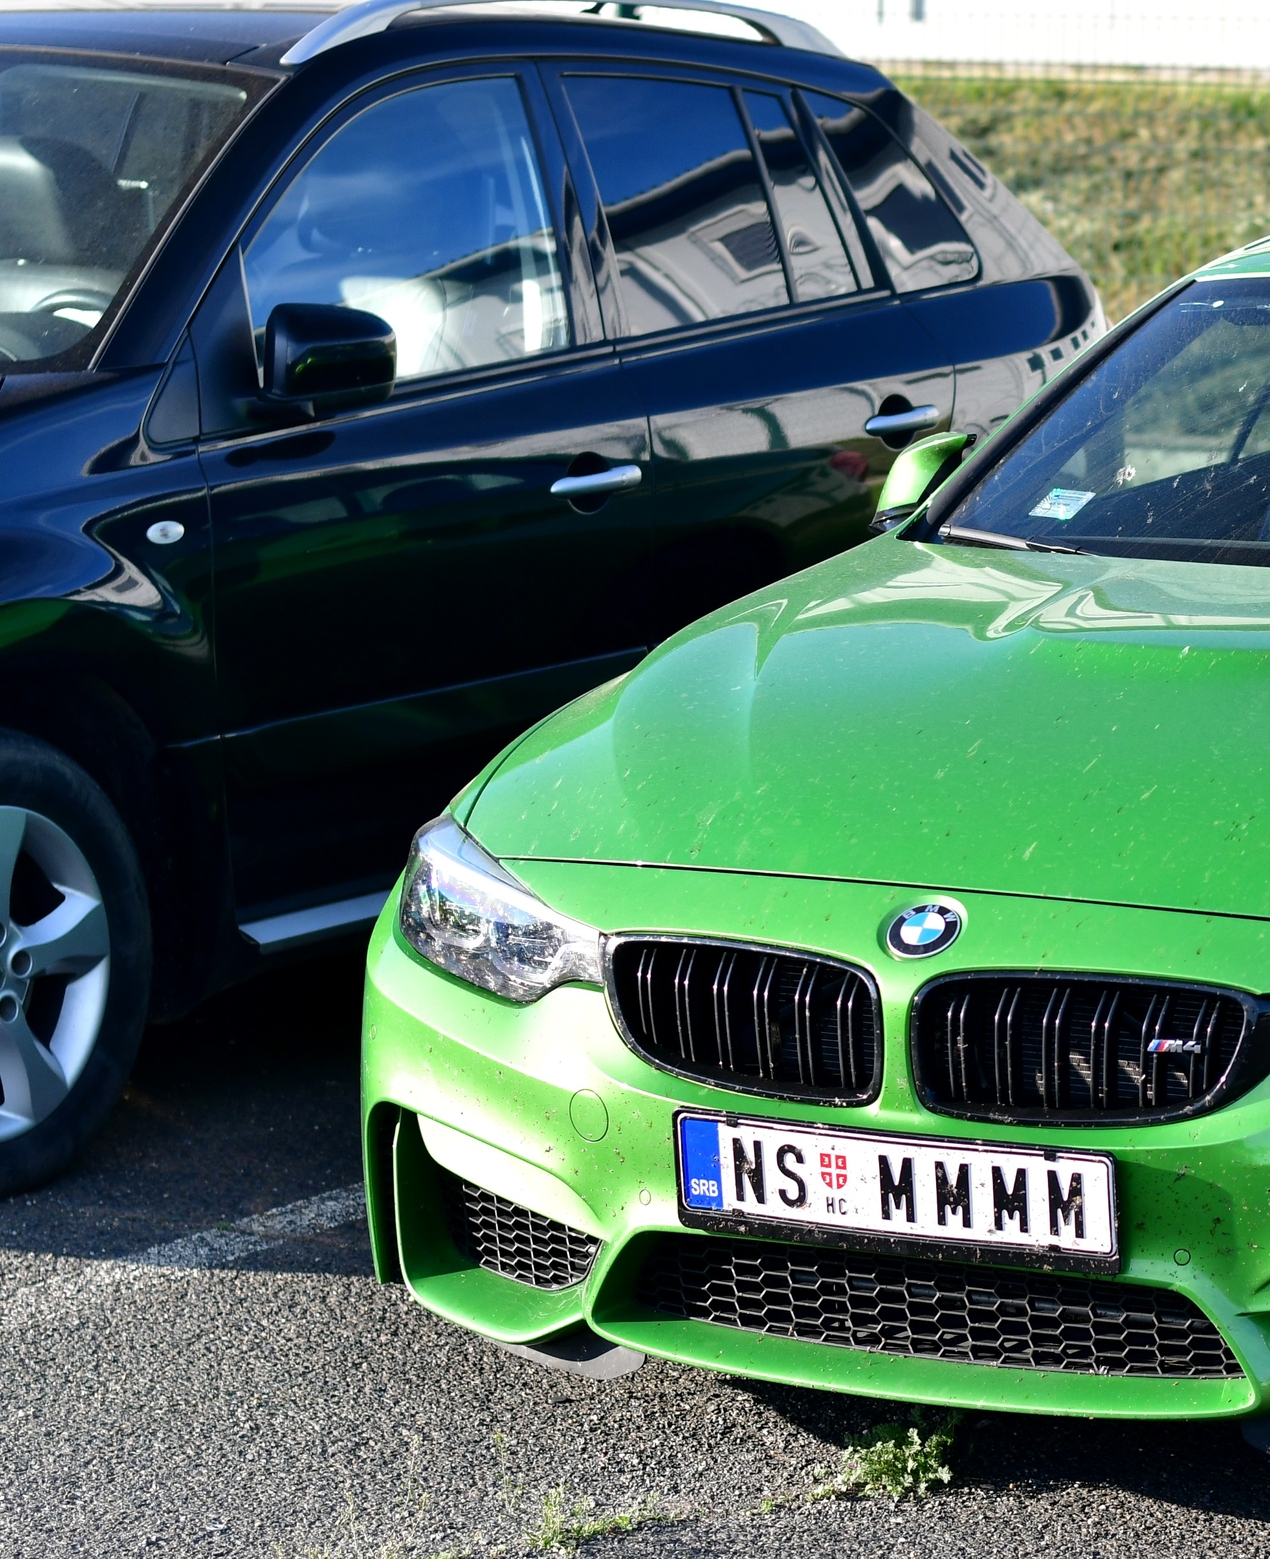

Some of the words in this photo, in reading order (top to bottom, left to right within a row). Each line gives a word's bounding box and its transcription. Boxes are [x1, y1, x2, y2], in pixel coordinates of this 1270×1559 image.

[902, 905, 957, 922] BMW
[1160, 1039, 1202, 1054] M4
[691, 1178, 718, 1197] SRB
[732, 1137, 806, 1207] NS
[878, 1154, 1085, 1239] MMMM
